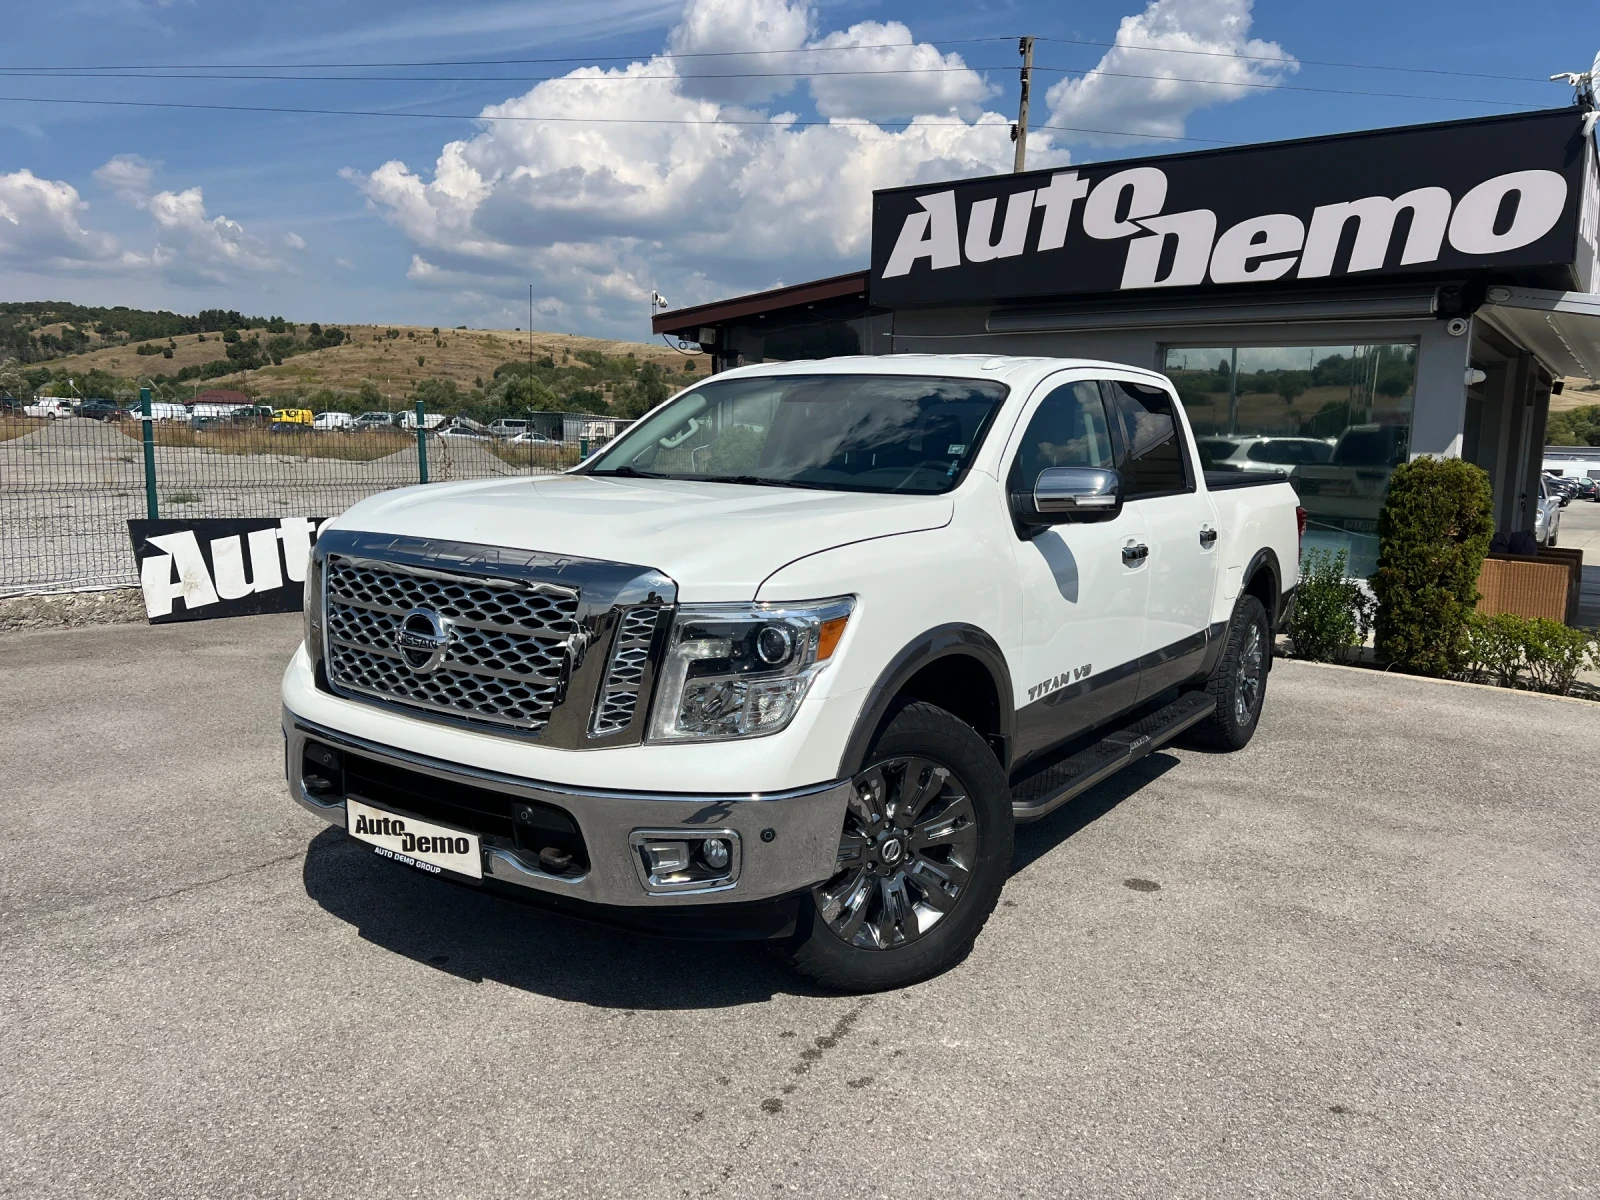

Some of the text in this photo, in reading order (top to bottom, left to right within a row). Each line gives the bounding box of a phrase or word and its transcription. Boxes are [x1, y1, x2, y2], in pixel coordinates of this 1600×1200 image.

[881, 167, 1168, 279] Auto
[1120, 170, 1568, 290] Demo
[140, 517, 339, 619] Aut
[399, 632, 440, 650] NISSAN
[1027, 663, 1092, 701] TITAN V8
[355, 815, 470, 854] Auto Demo
[374, 847, 441, 874] AUTO DEMO GROUP
